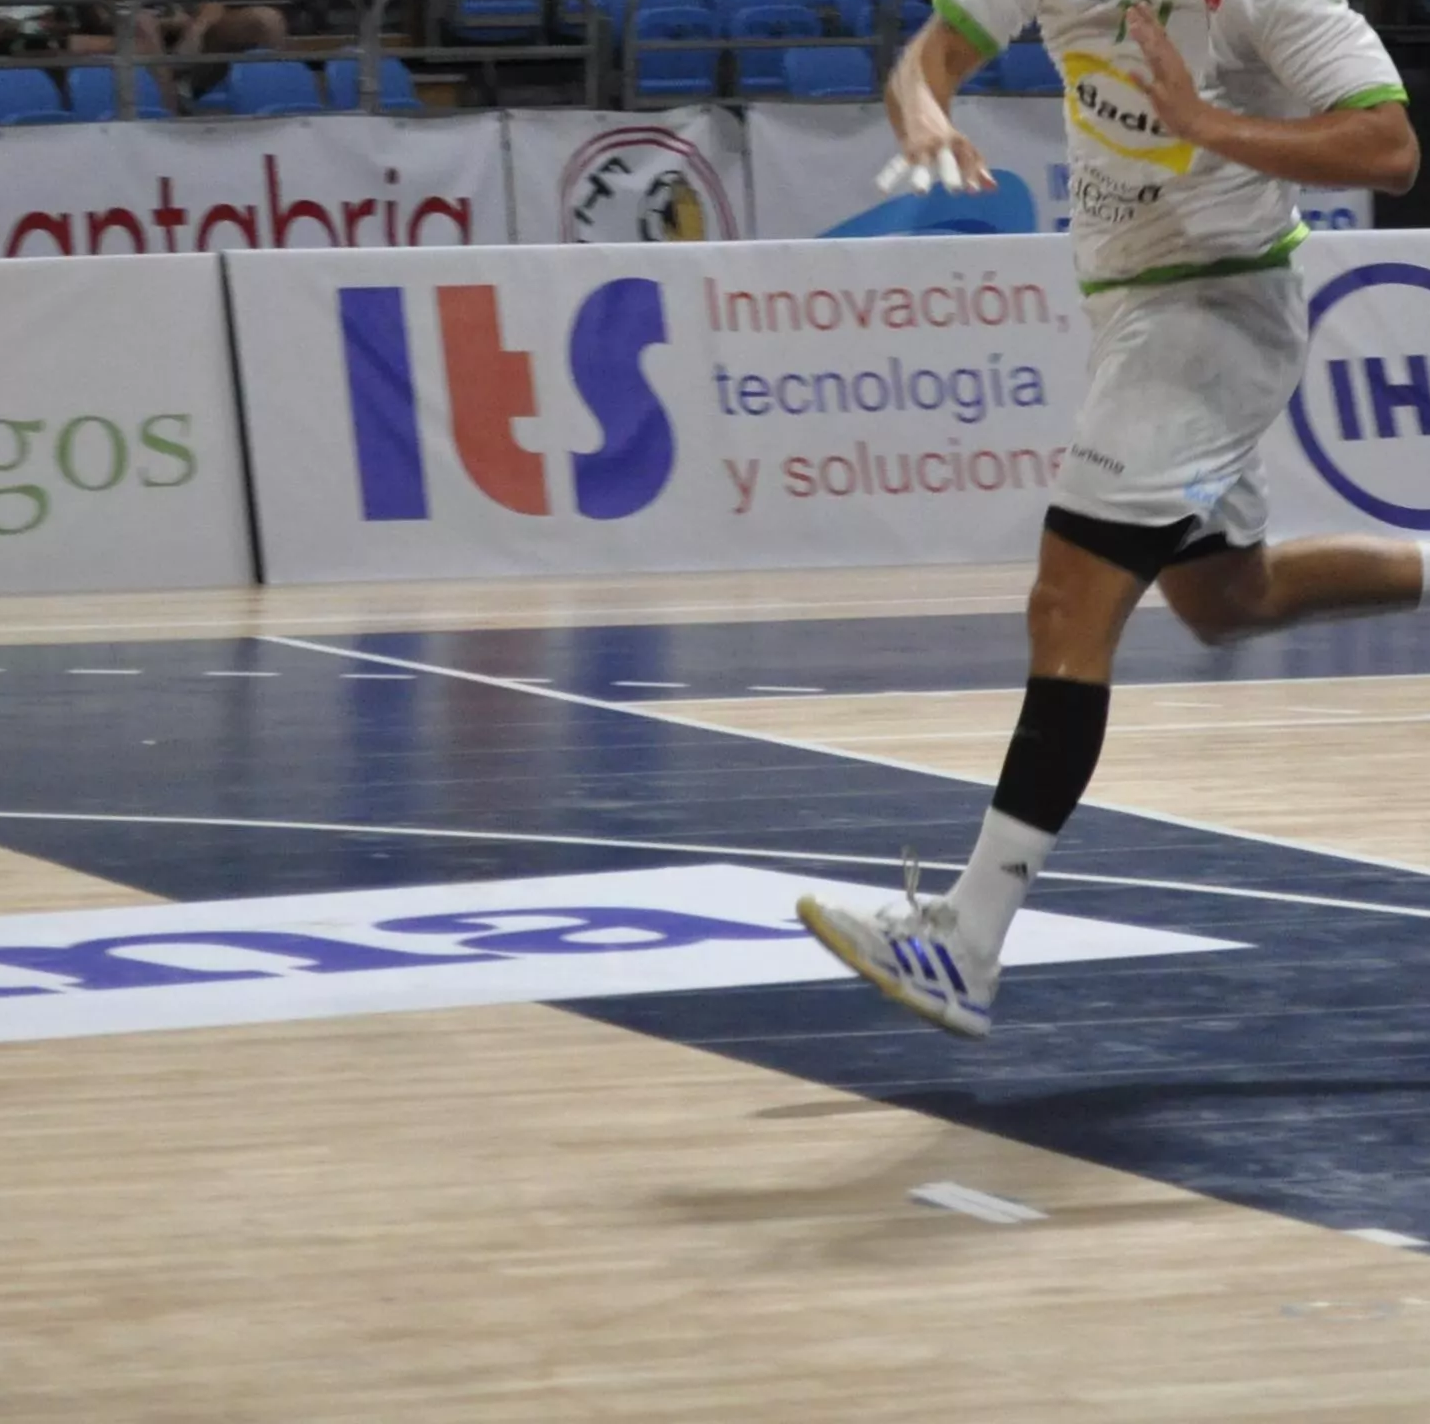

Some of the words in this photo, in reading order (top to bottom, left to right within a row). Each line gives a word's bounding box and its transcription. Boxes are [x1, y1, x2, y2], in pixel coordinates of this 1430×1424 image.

[702, 271, 1069, 333] Innovación,
[712, 352, 1048, 424] tecnología
[722, 458, 761, 515] y
